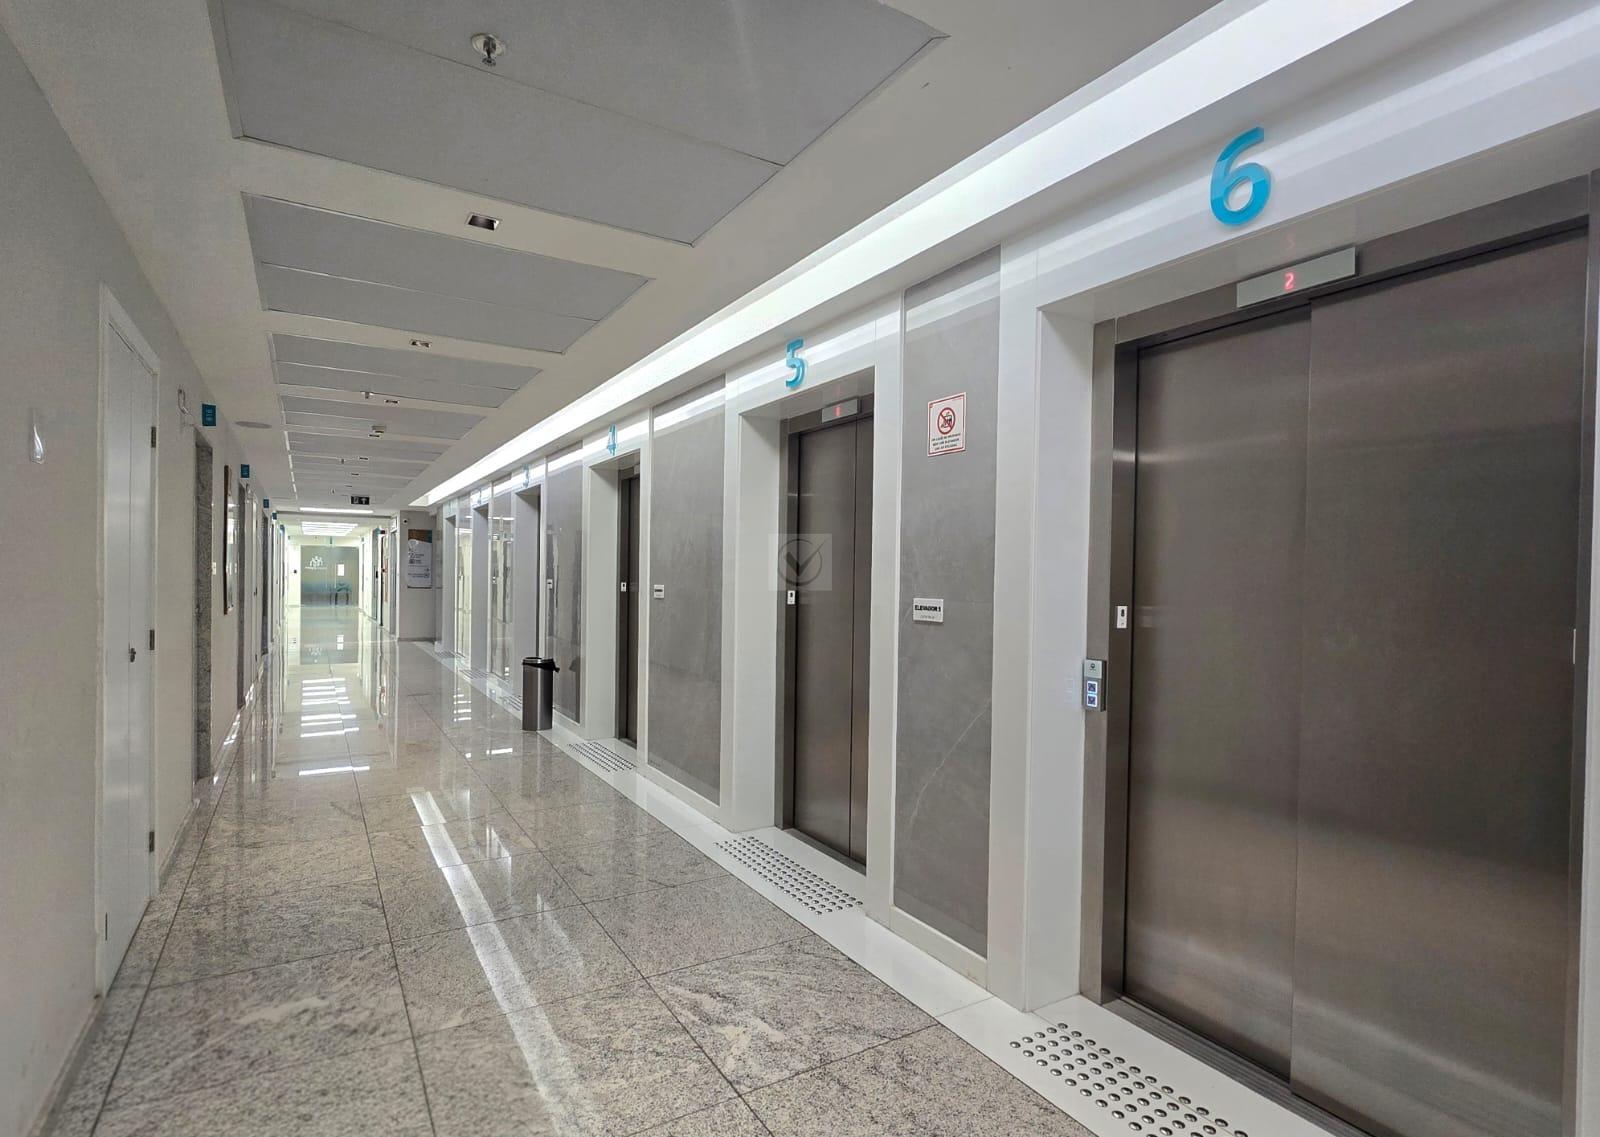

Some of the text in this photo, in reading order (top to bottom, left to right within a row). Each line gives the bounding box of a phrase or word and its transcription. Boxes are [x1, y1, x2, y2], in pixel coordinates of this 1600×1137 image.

[1210, 126, 1272, 226] 6
[1284, 272, 1295, 291] 2
[786, 338, 805, 389] 5
[607, 423, 616, 456] 4
